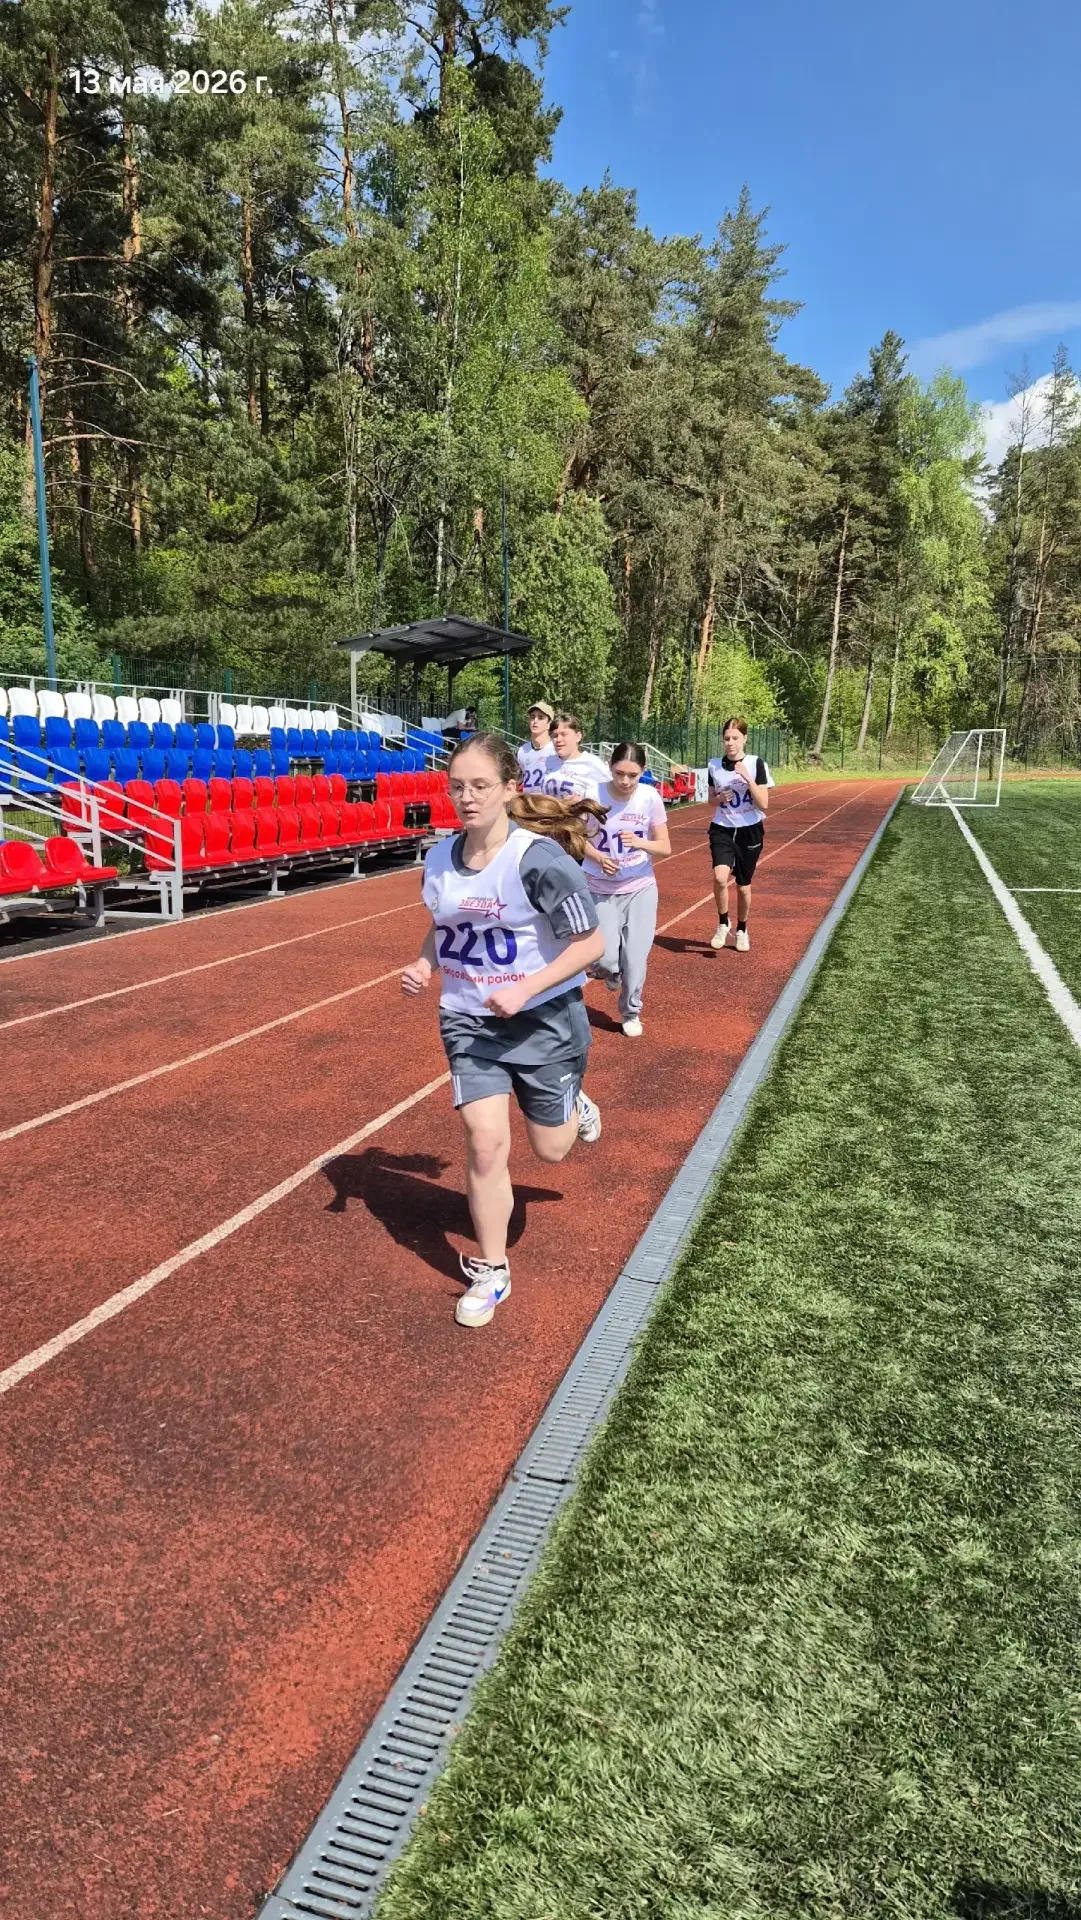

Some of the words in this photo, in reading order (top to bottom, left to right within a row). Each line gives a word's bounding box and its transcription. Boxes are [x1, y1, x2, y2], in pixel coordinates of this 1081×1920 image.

[720, 789, 753, 808] 04
[436, 922, 518, 966] 220
[487, 971, 526, 986] район
